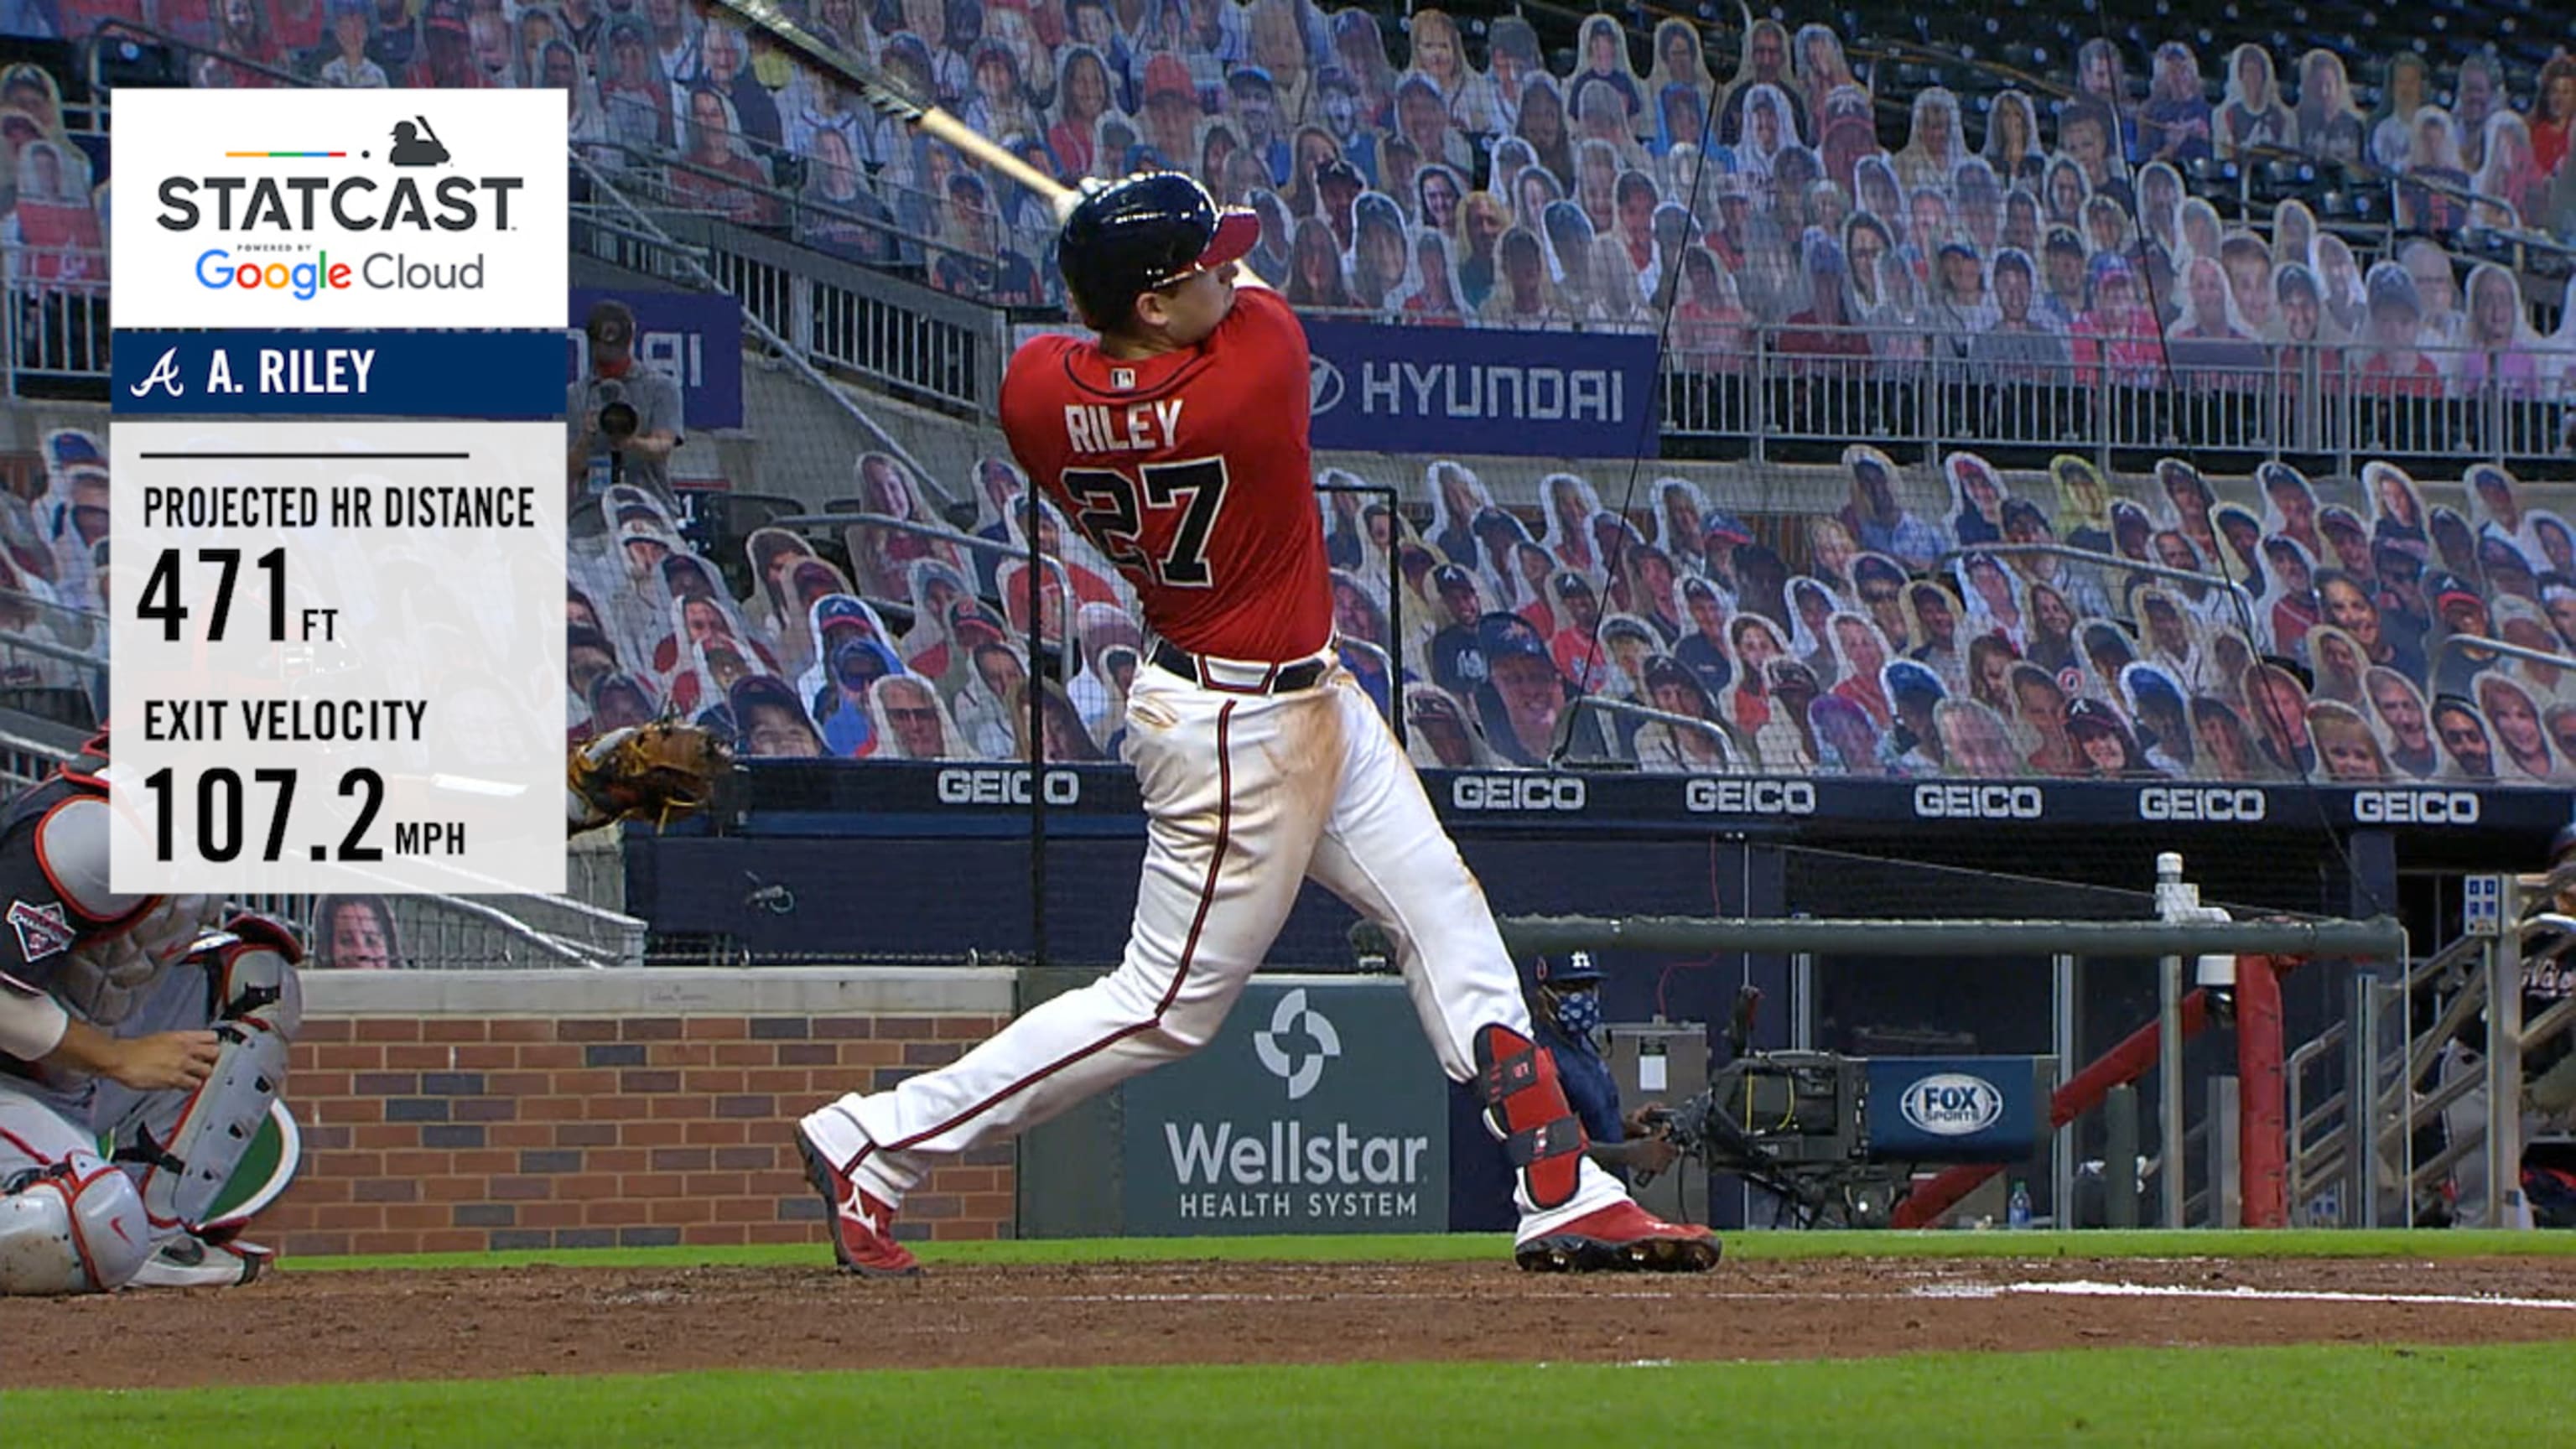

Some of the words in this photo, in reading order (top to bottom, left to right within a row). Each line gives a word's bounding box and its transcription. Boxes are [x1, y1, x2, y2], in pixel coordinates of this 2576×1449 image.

[1362, 361, 1623, 423] HYUNDAI
[1064, 399, 1184, 453] RILEY
[1060, 454, 1229, 587] 27
[937, 769, 1079, 804] GEICO
[1452, 776, 1585, 810] GEICO
[1685, 778, 1816, 813] GEICO
[1914, 785, 2043, 818] GEICO
[2139, 787, 2266, 821] GEICO
[2354, 791, 2480, 823] GEICO
[1924, 1087, 1979, 1111] FOX
[1925, 1111, 1980, 1122] SPORTS
[1164, 1120, 1428, 1185] Wellstar
[1180, 1192, 1291, 1218] HEALTH
[1308, 1192, 1417, 1217] SYSTEM
